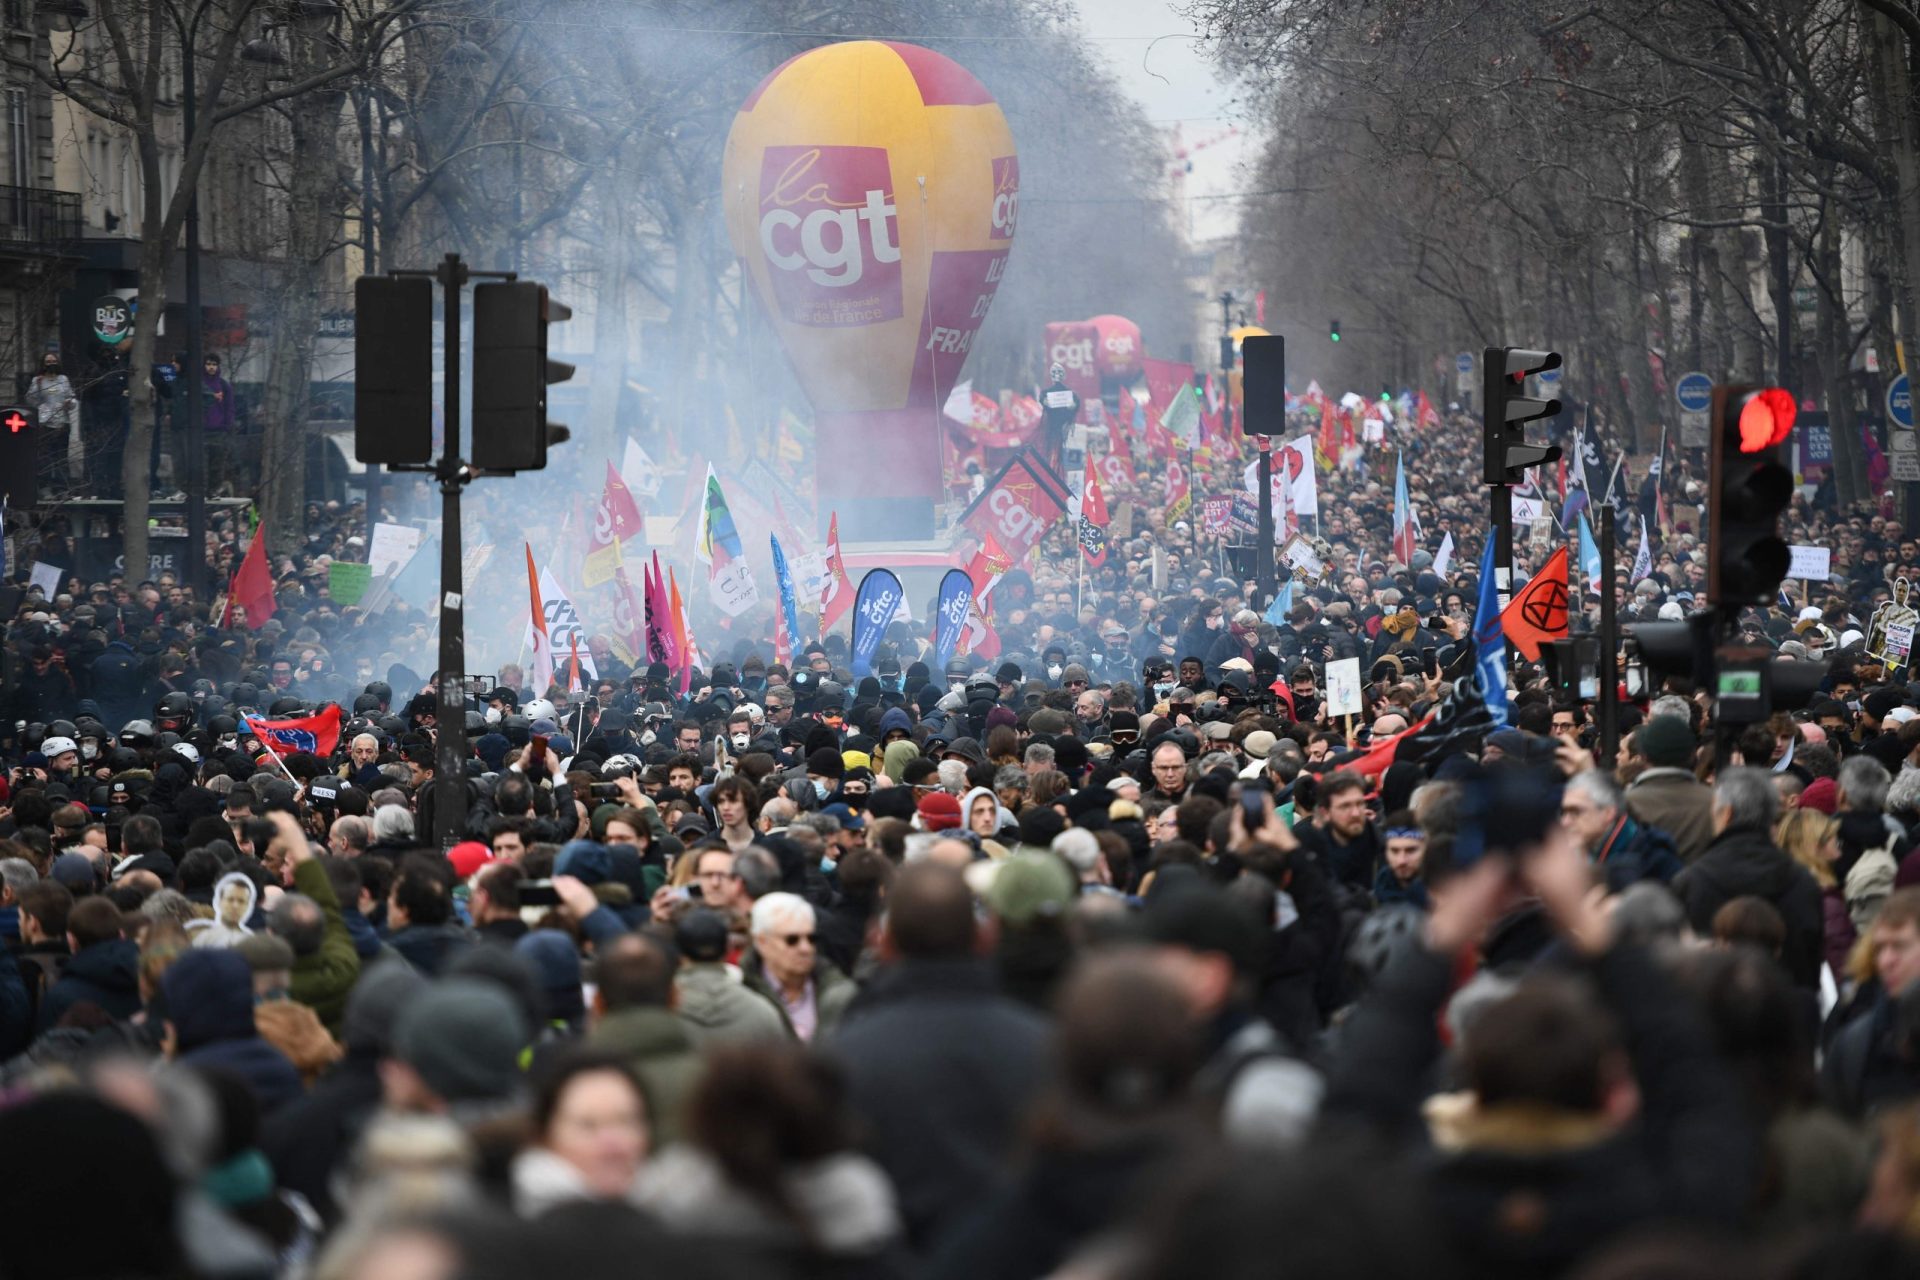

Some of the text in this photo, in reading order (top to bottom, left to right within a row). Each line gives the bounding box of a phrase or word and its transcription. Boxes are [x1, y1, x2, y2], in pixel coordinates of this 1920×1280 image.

[992, 191, 1018, 237] cg
[759, 189, 901, 288] cgt
[96, 308, 126, 322] BUS
[1051, 337, 1094, 370] cgt
[1105, 335, 1134, 355] cgt
[989, 488, 1045, 547] cgt
[870, 590, 894, 625] cftc
[950, 590, 967, 625] cftc
[312, 788, 335, 798] PRESS
